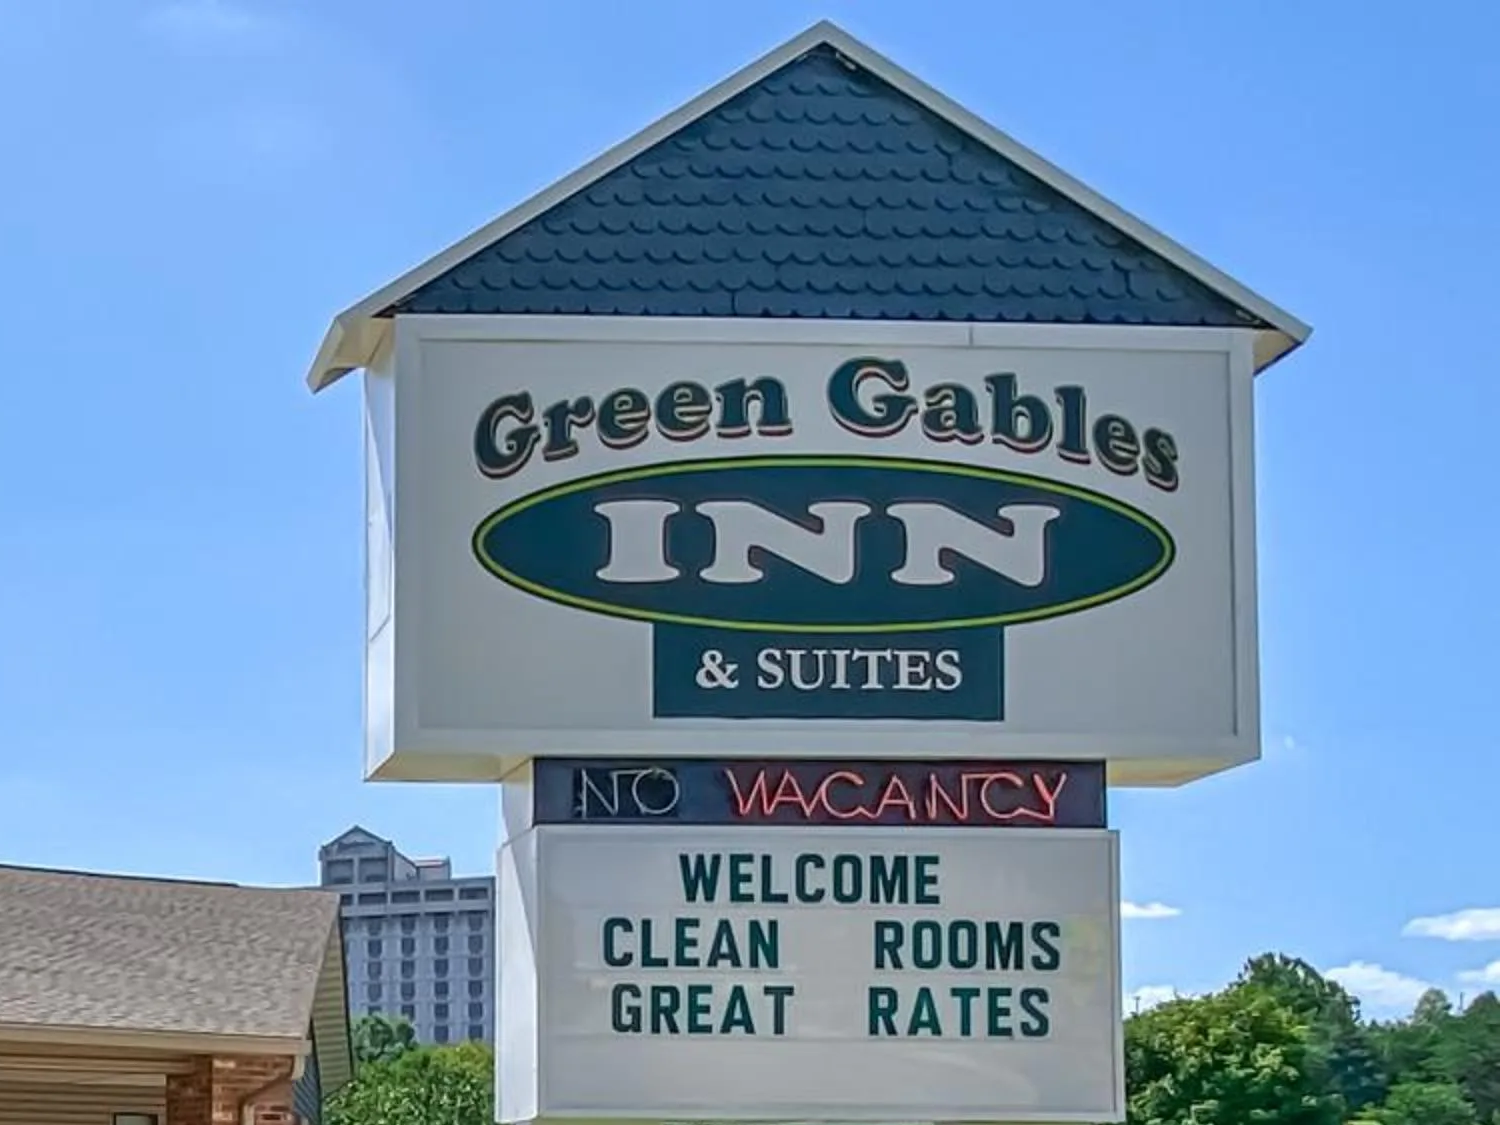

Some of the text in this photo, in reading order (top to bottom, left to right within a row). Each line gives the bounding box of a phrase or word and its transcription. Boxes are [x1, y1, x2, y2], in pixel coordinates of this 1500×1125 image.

[474, 356, 1180, 492] Green Gables
[593, 500, 1061, 587] INN
[695, 648, 963, 691] & SUITES
[578, 768, 1066, 820] NO VACANCY
[678, 853, 941, 905] WELCOME
[602, 917, 1062, 972] CLEAN ROOMS
[610, 983, 1051, 1038] GREAT RATES
